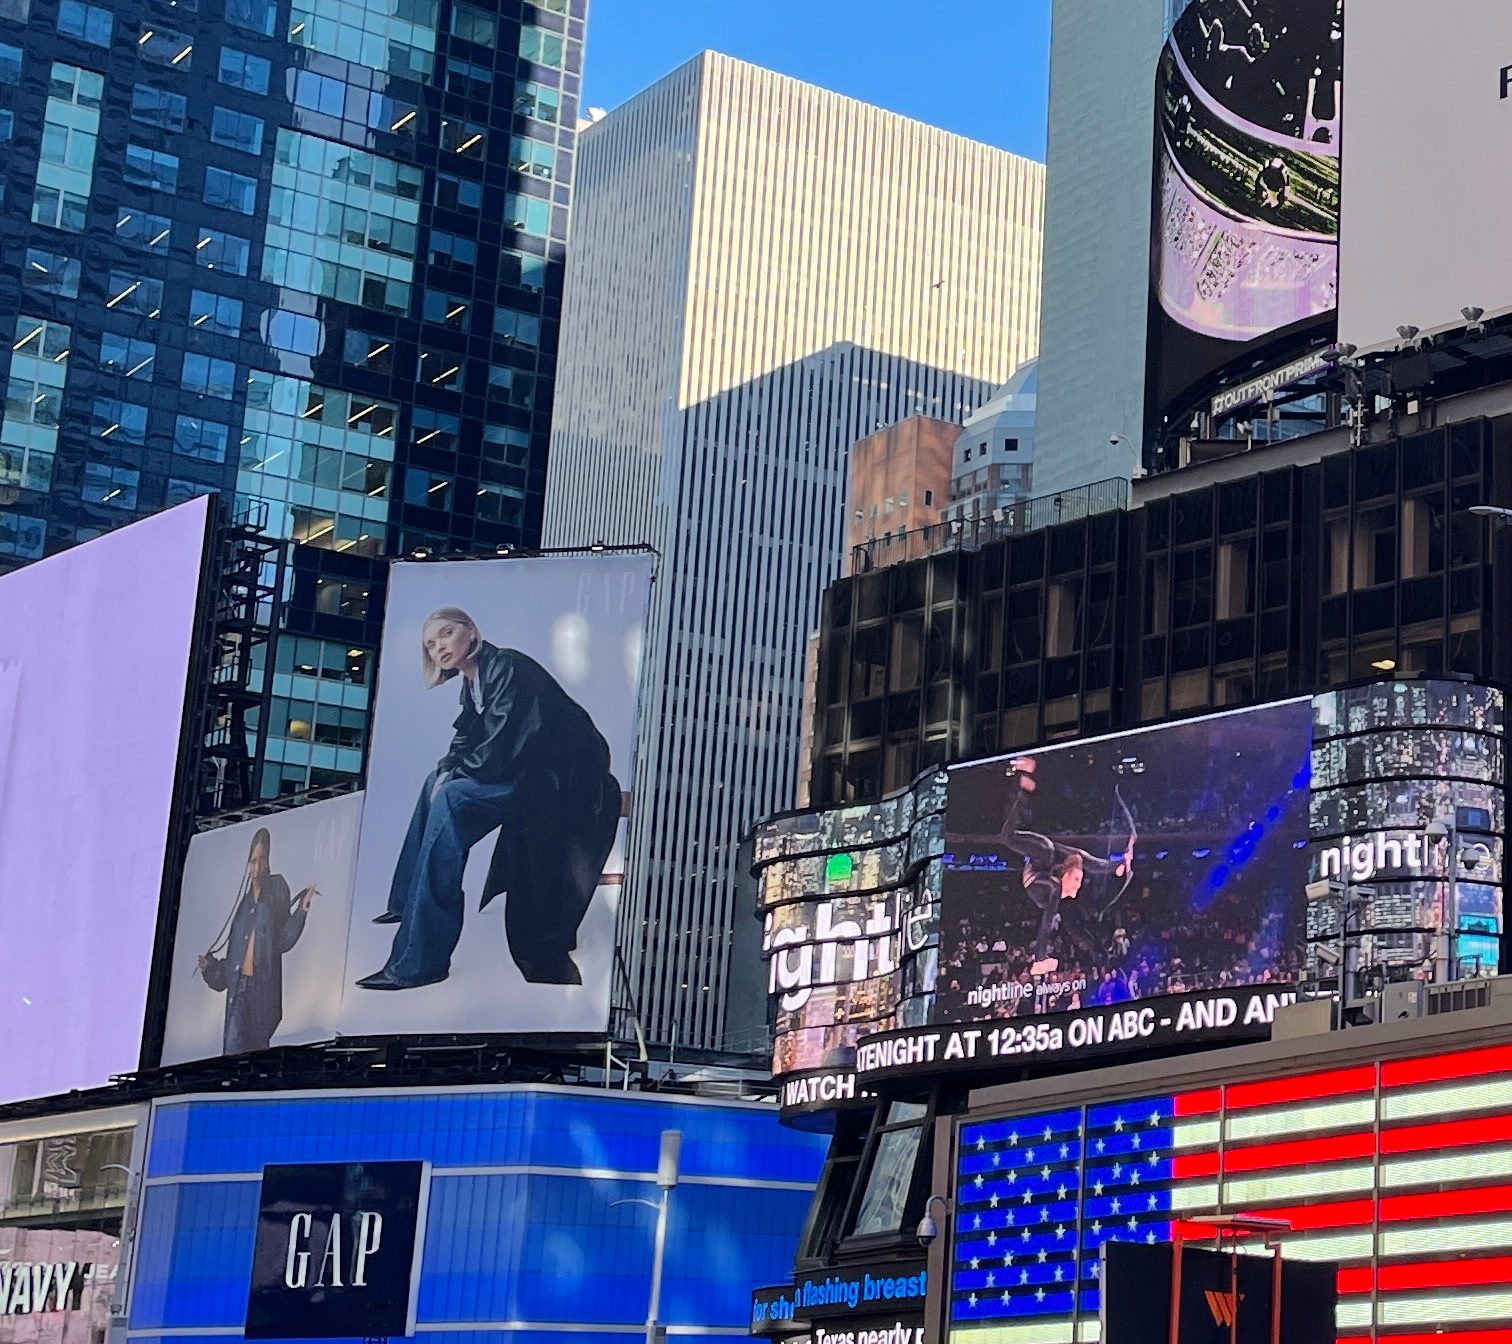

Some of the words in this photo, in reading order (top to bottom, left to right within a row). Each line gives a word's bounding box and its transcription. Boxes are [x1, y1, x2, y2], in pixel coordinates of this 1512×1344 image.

[967, 982, 1034, 1008] nightline
[1035, 981, 1071, 999] always
[1072, 978, 1087, 991] on
[944, 1030, 982, 1060] AT
[987, 1022, 1063, 1056] 12:35a
[1068, 1015, 1103, 1047] ON
[1107, 1008, 1156, 1043] ABC
[1177, 998, 1237, 1033] AND
[786, 1074, 856, 1106] WATCH
[285, 1212, 383, 1289] GAP
[863, 1269, 927, 1302] breast
